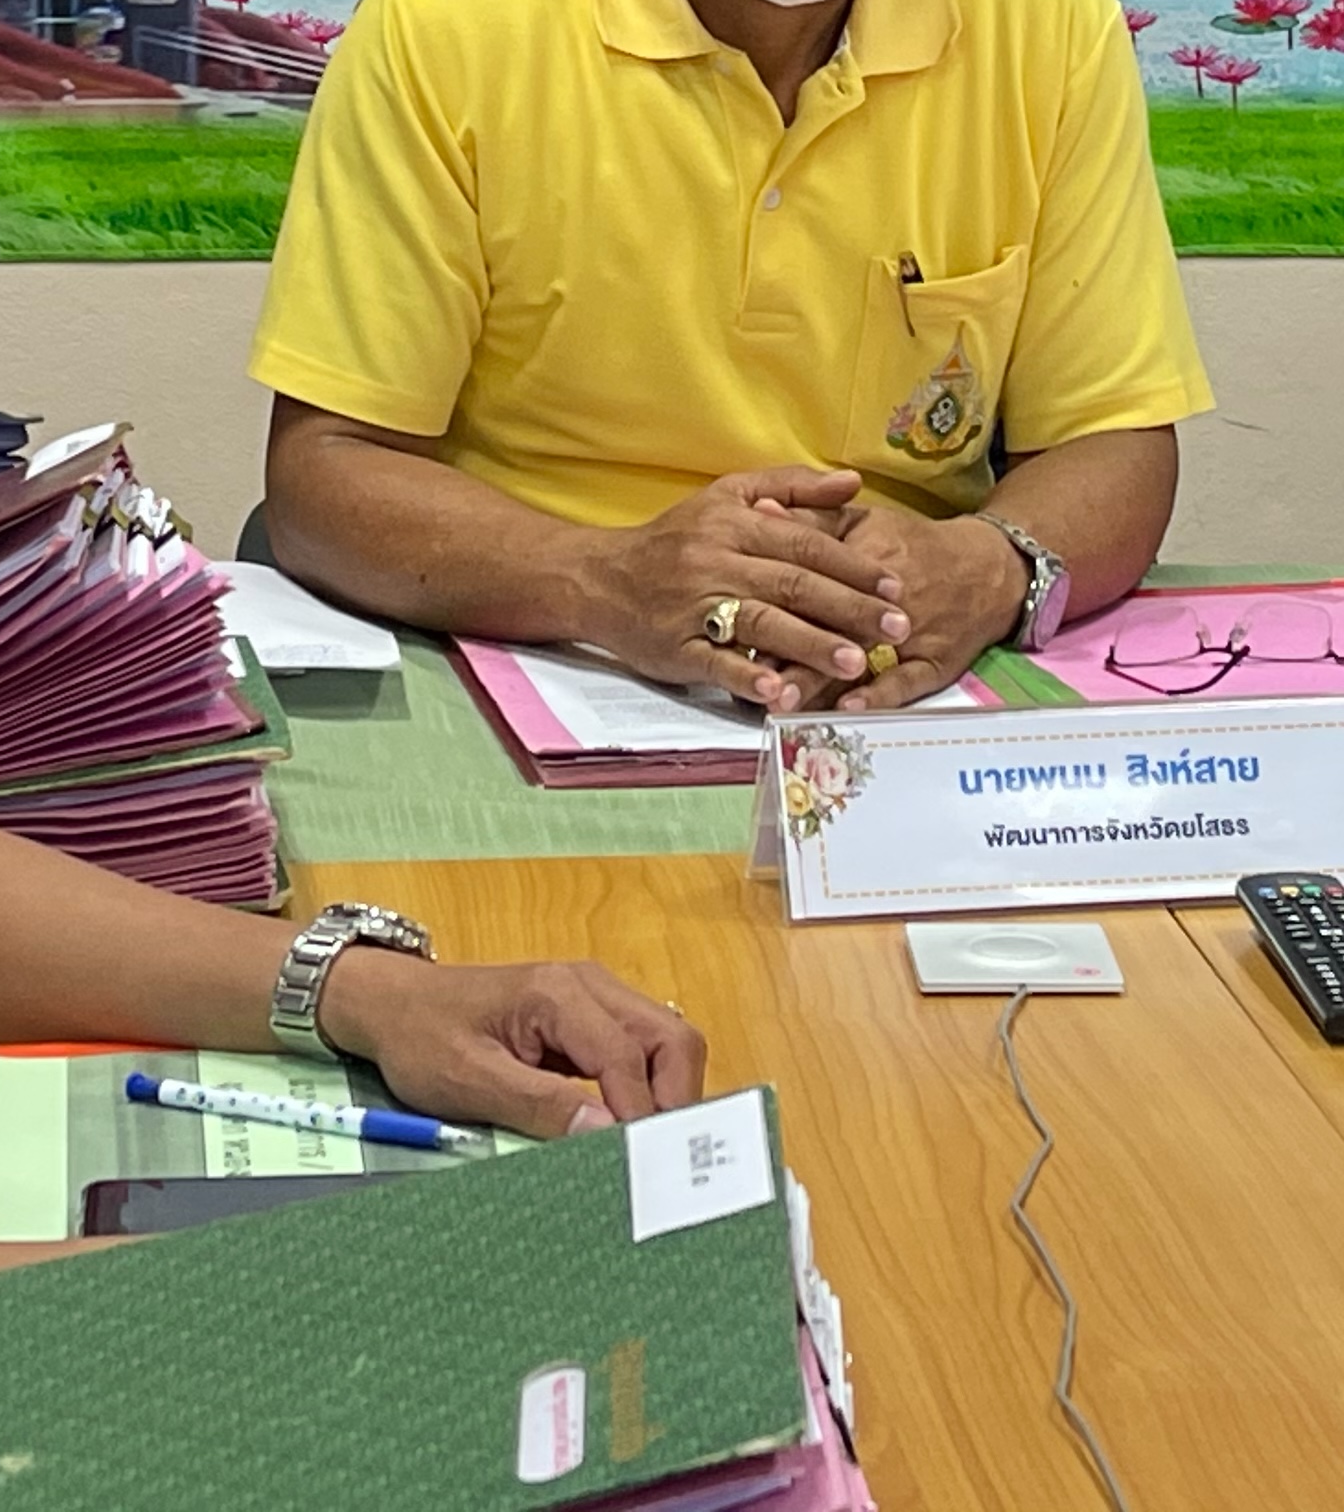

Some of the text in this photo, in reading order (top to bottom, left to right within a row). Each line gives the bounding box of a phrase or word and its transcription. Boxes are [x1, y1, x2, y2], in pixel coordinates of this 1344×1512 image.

[1125, 748, 1259, 786] สิงห์สาย
[983, 813, 1250, 848] พัฒนาการจังหวัดยโสธร
